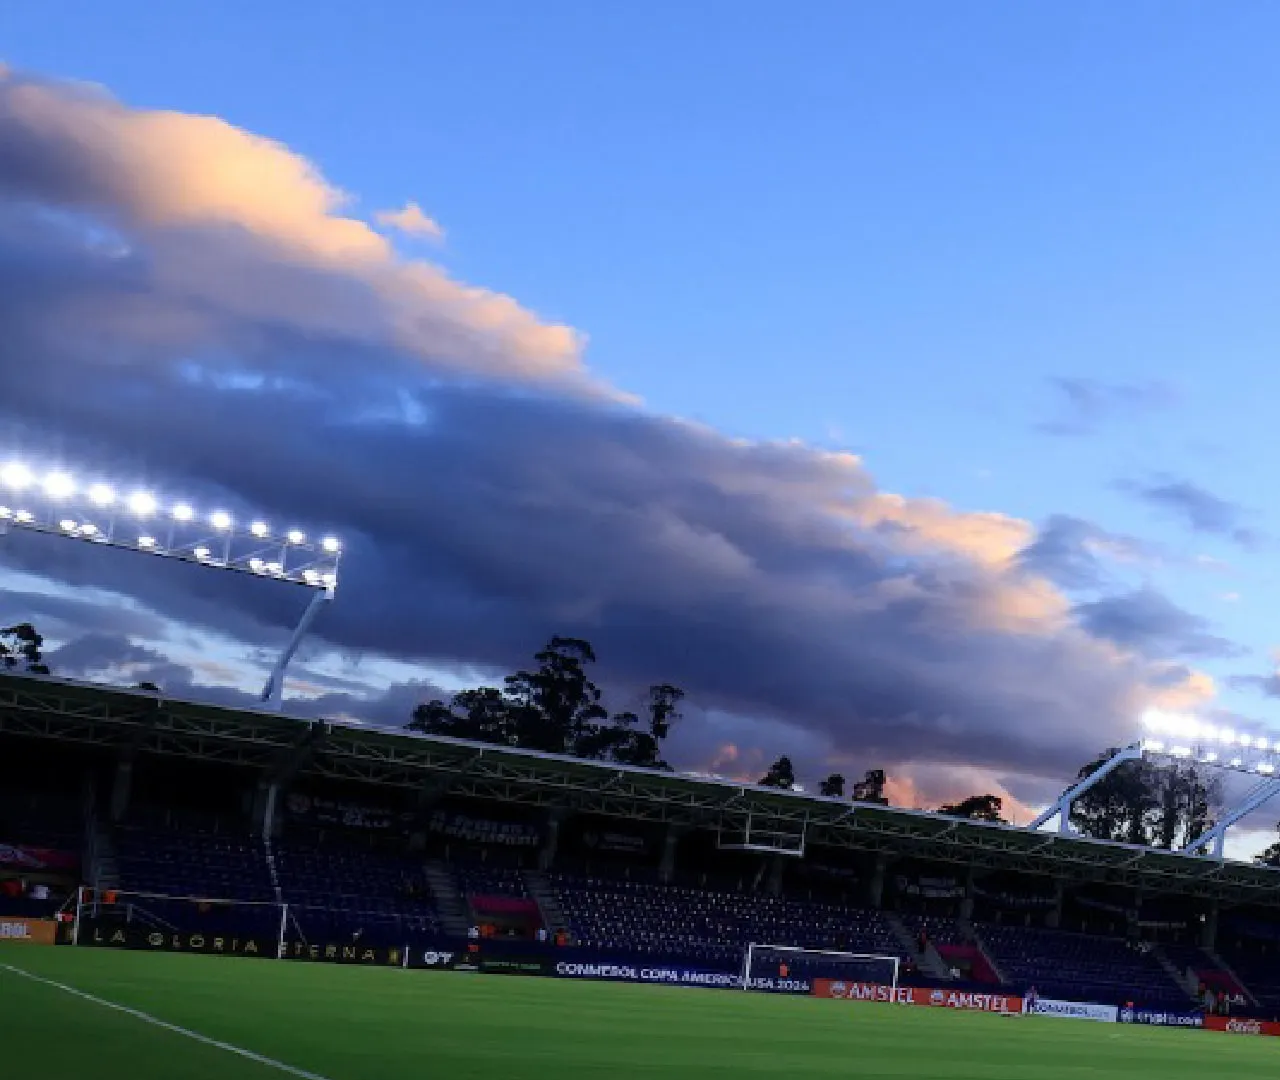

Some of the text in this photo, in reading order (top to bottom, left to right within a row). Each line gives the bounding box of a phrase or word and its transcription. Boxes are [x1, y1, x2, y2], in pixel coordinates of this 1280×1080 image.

[94, 928, 375, 960] LA GLORIA ETERNA
[557, 962, 638, 978] CONMEBOL
[640, 967, 678, 981] COPA
[850, 983, 914, 1003] AMSTEL
[949, 991, 1008, 1012] AMSTEL
